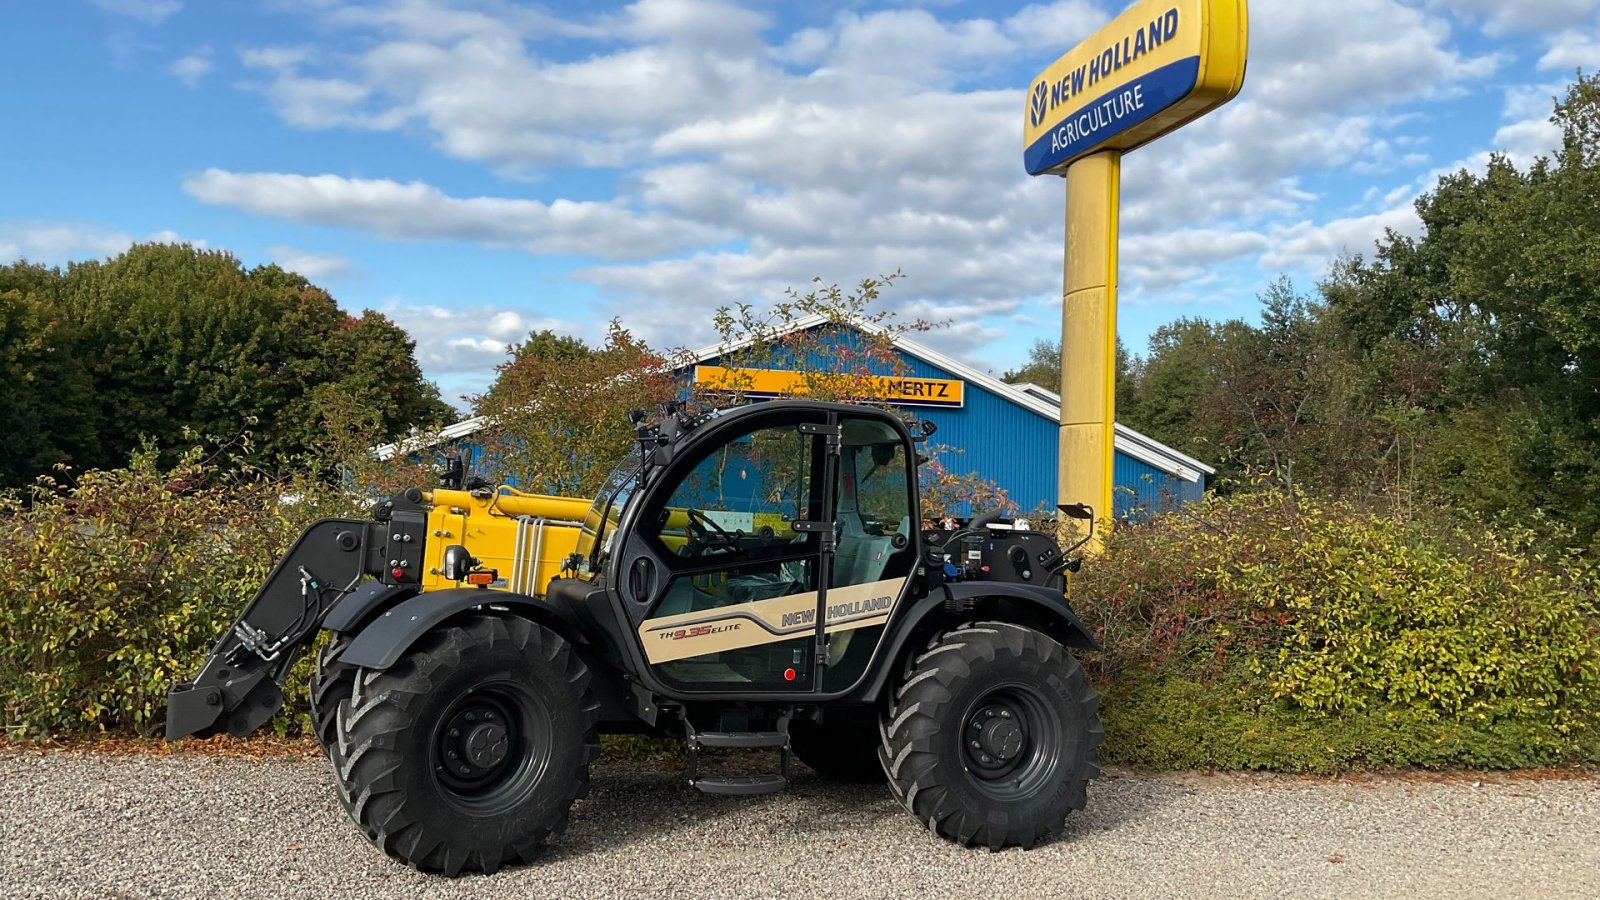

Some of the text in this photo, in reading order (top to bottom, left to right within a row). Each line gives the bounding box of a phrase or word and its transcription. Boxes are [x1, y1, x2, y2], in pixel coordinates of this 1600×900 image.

[1050, 7, 1179, 110] NEW HOLLAND
[1051, 84, 1144, 154] AGRICULTURE
[781, 596, 892, 627] NEW HOLLAND
